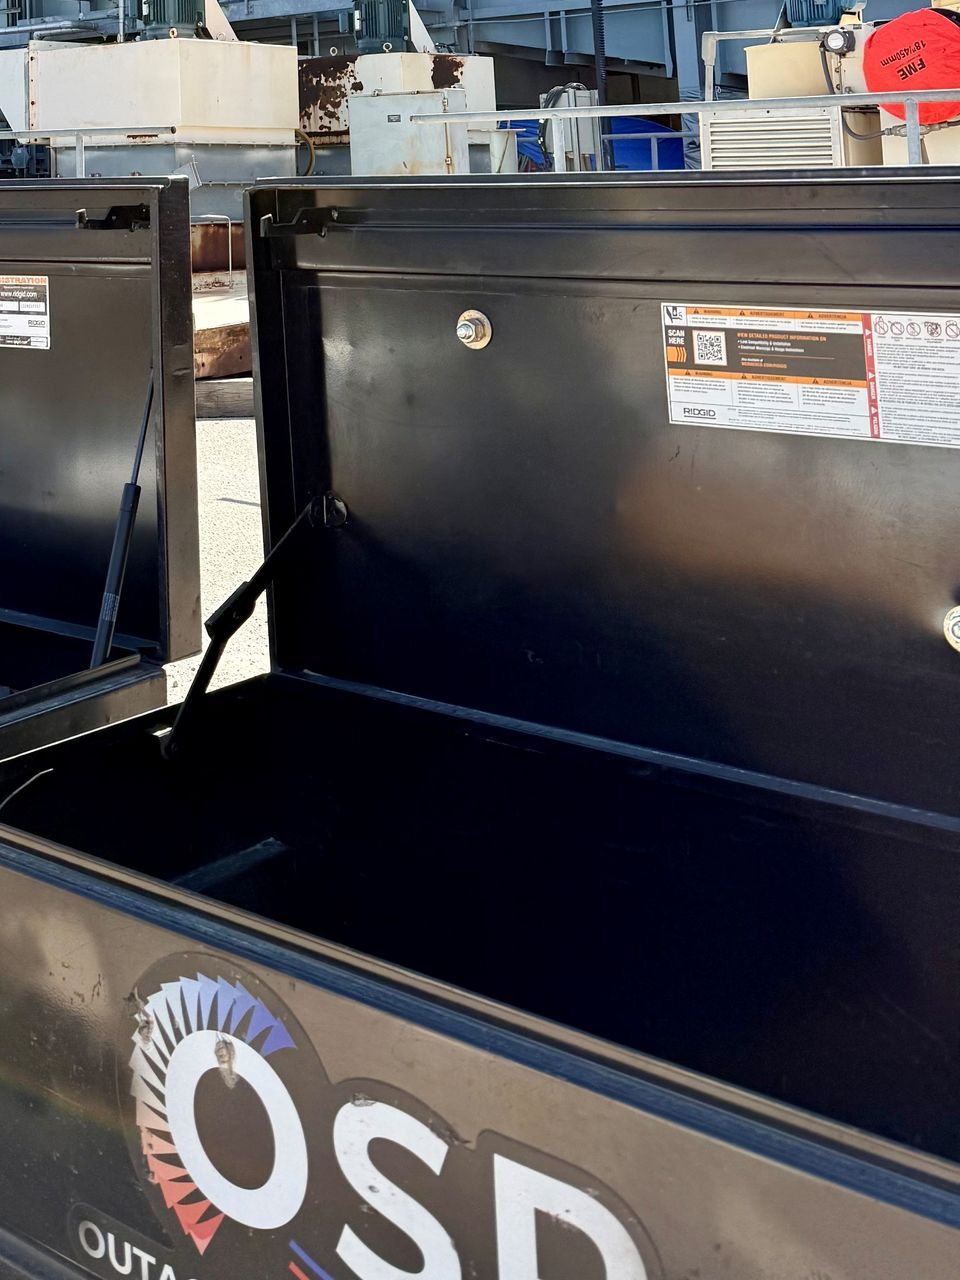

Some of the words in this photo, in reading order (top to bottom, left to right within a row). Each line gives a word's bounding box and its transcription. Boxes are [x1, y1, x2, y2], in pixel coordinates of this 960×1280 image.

[896, 57, 927, 80] FME
[667, 329, 685, 337] SCAN
[668, 337, 685, 345] HERE
[683, 407, 716, 417] RIDGID
[78, 1220, 198, 1280] OUT
